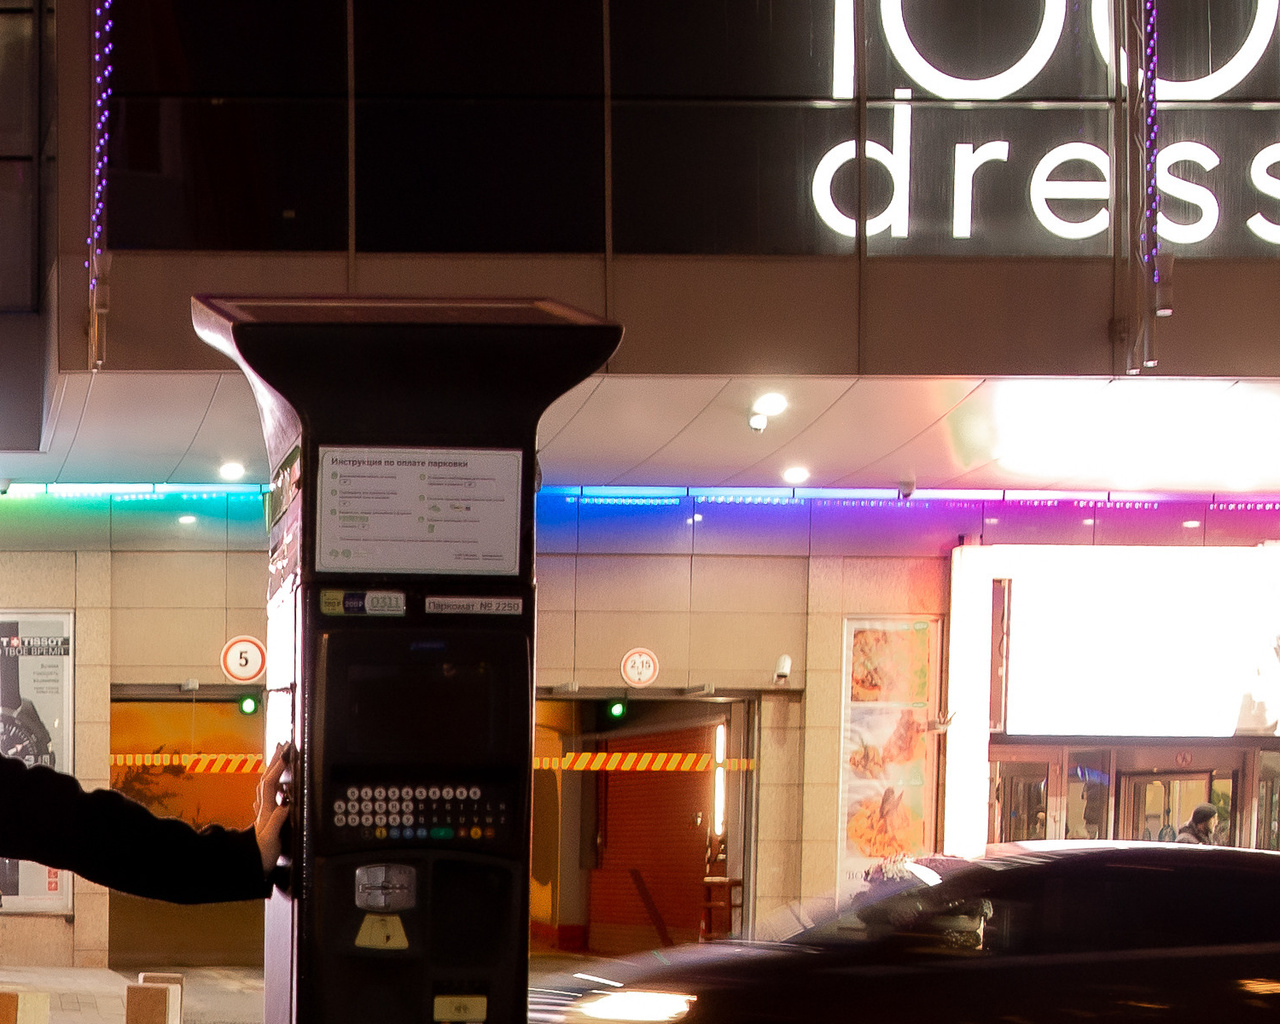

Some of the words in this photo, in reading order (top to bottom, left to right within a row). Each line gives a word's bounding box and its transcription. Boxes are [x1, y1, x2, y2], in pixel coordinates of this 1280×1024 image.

[331, 457, 382, 467] Инструкция
[384, 459, 394, 467] по
[396, 459, 426, 467] оплате
[427, 460, 468, 469] парковки
[370, 596, 401, 609] 0311
[428, 601, 475, 612] Паркомат
[21, 637, 64, 647] TISSOT
[5, 647, 29, 657] ТВОЕ
[31, 647, 64, 656] ВРЕМЯ
[239, 651, 249, 667] 5
